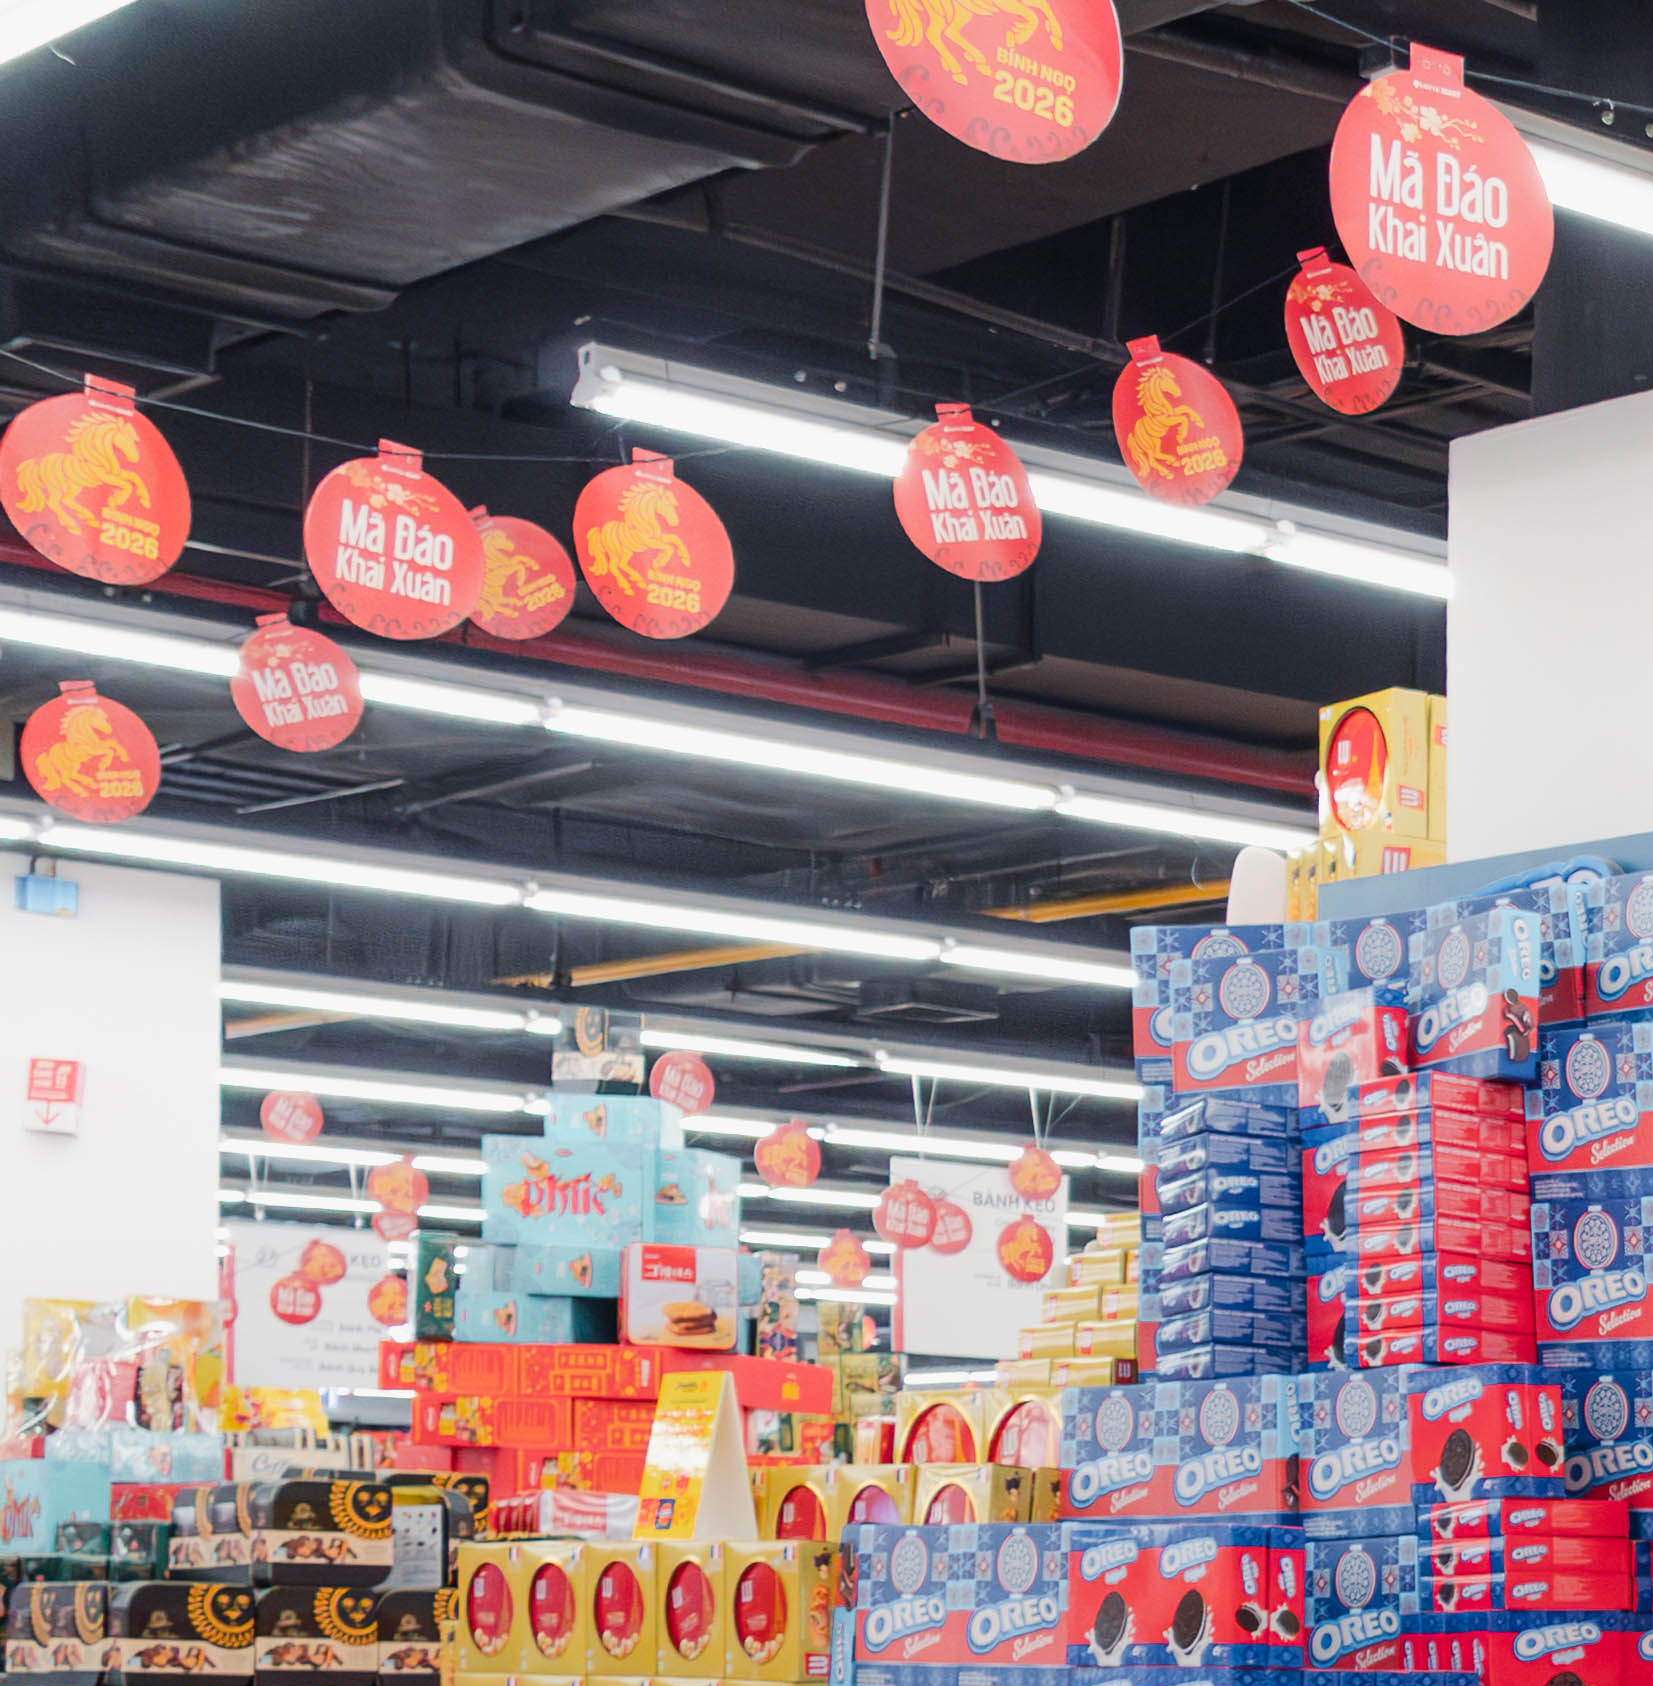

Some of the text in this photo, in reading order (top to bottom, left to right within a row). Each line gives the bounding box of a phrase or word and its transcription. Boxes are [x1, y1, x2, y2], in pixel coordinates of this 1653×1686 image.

[996, 45, 1076, 94] BÍNH NGỌ
[993, 70, 1075, 128] 2026
[1369, 134, 1509, 226] Mã Đáo
[1368, 211, 1510, 280] Khai Xuân
[1300, 305, 1379, 354] Mã Đáo
[1314, 339, 1389, 384] Khai Xuân
[100, 525, 159, 560] 2026
[340, 499, 454, 571] Mã Đáo
[335, 546, 451, 606] Khai Xuân
[1539, 1097, 1639, 1158] OREO
[1590, 1130, 1636, 1165] Selection
[1175, 1448, 1262, 1505] OREO
